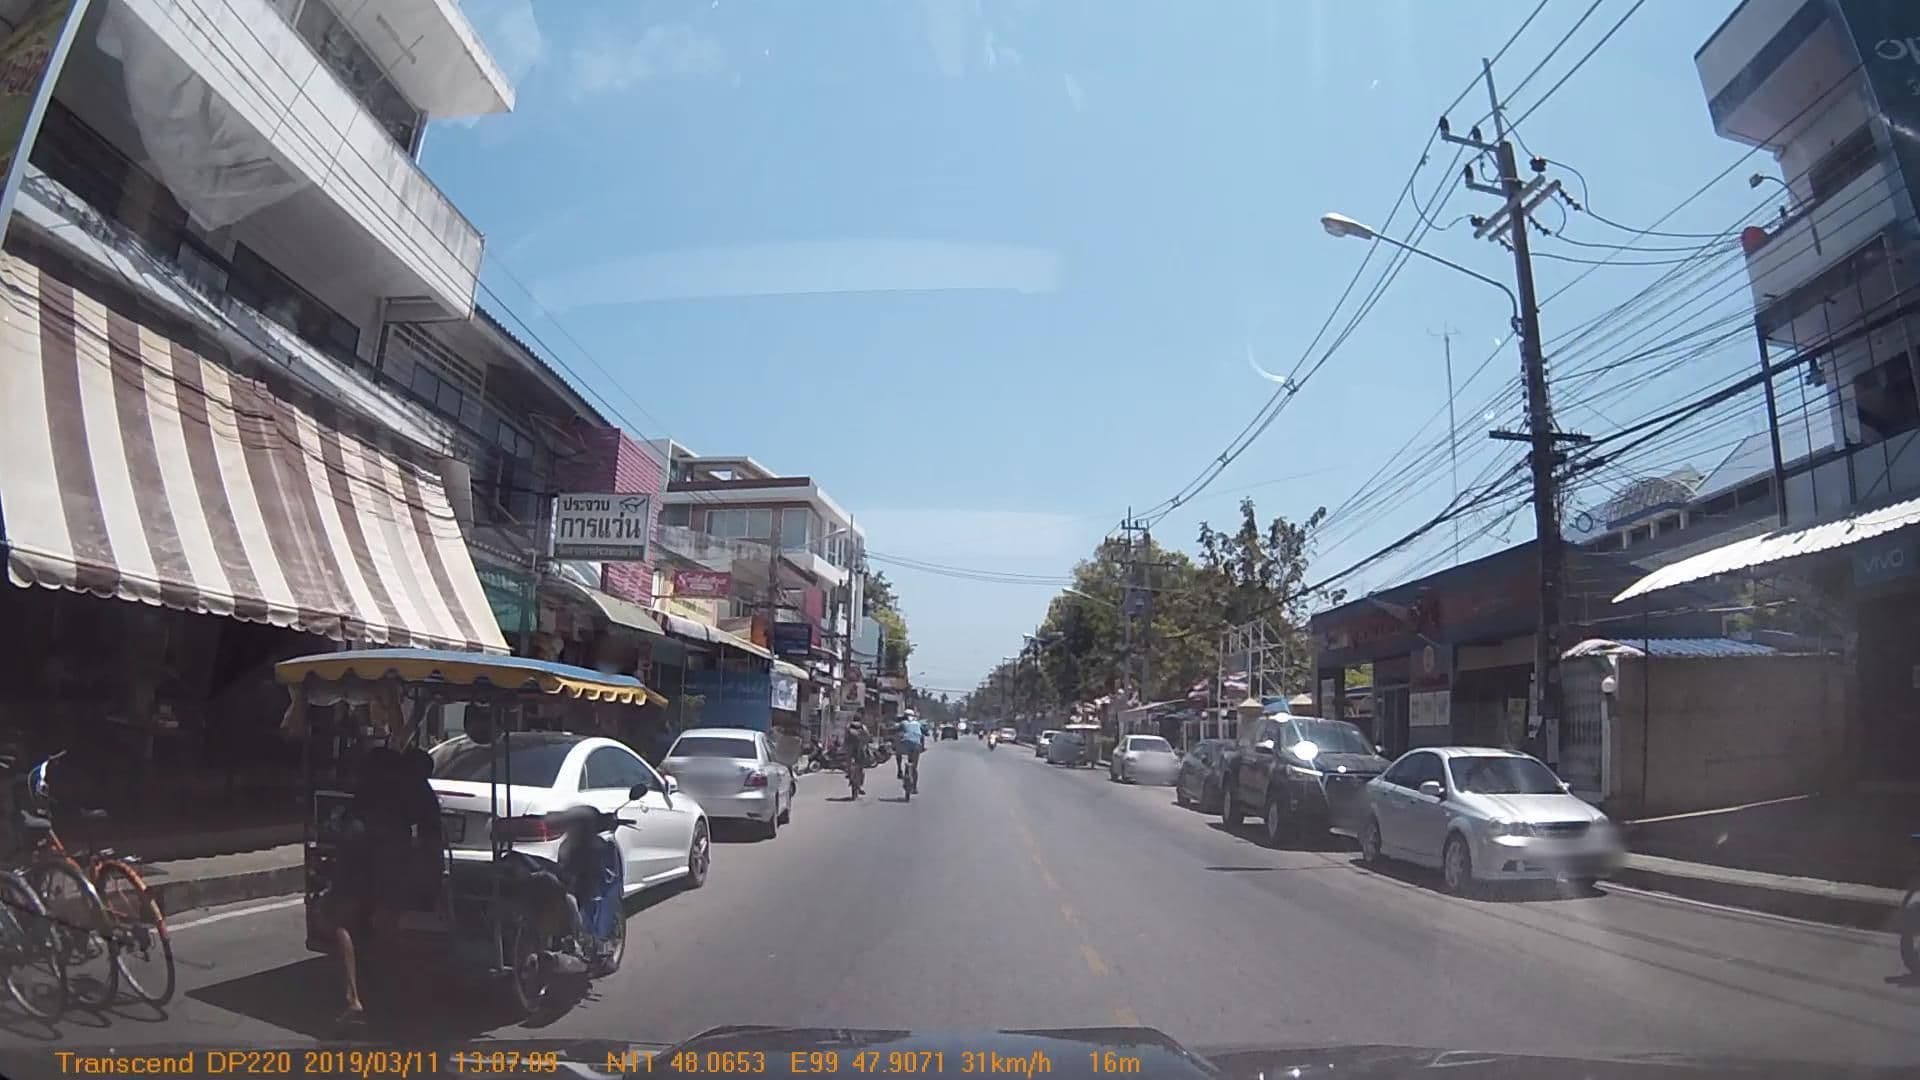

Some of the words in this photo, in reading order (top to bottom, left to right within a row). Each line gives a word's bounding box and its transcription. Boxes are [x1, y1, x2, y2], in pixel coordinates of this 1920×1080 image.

[563, 497, 610, 511] ประจวบ
[561, 512, 641, 538] การแว่น
